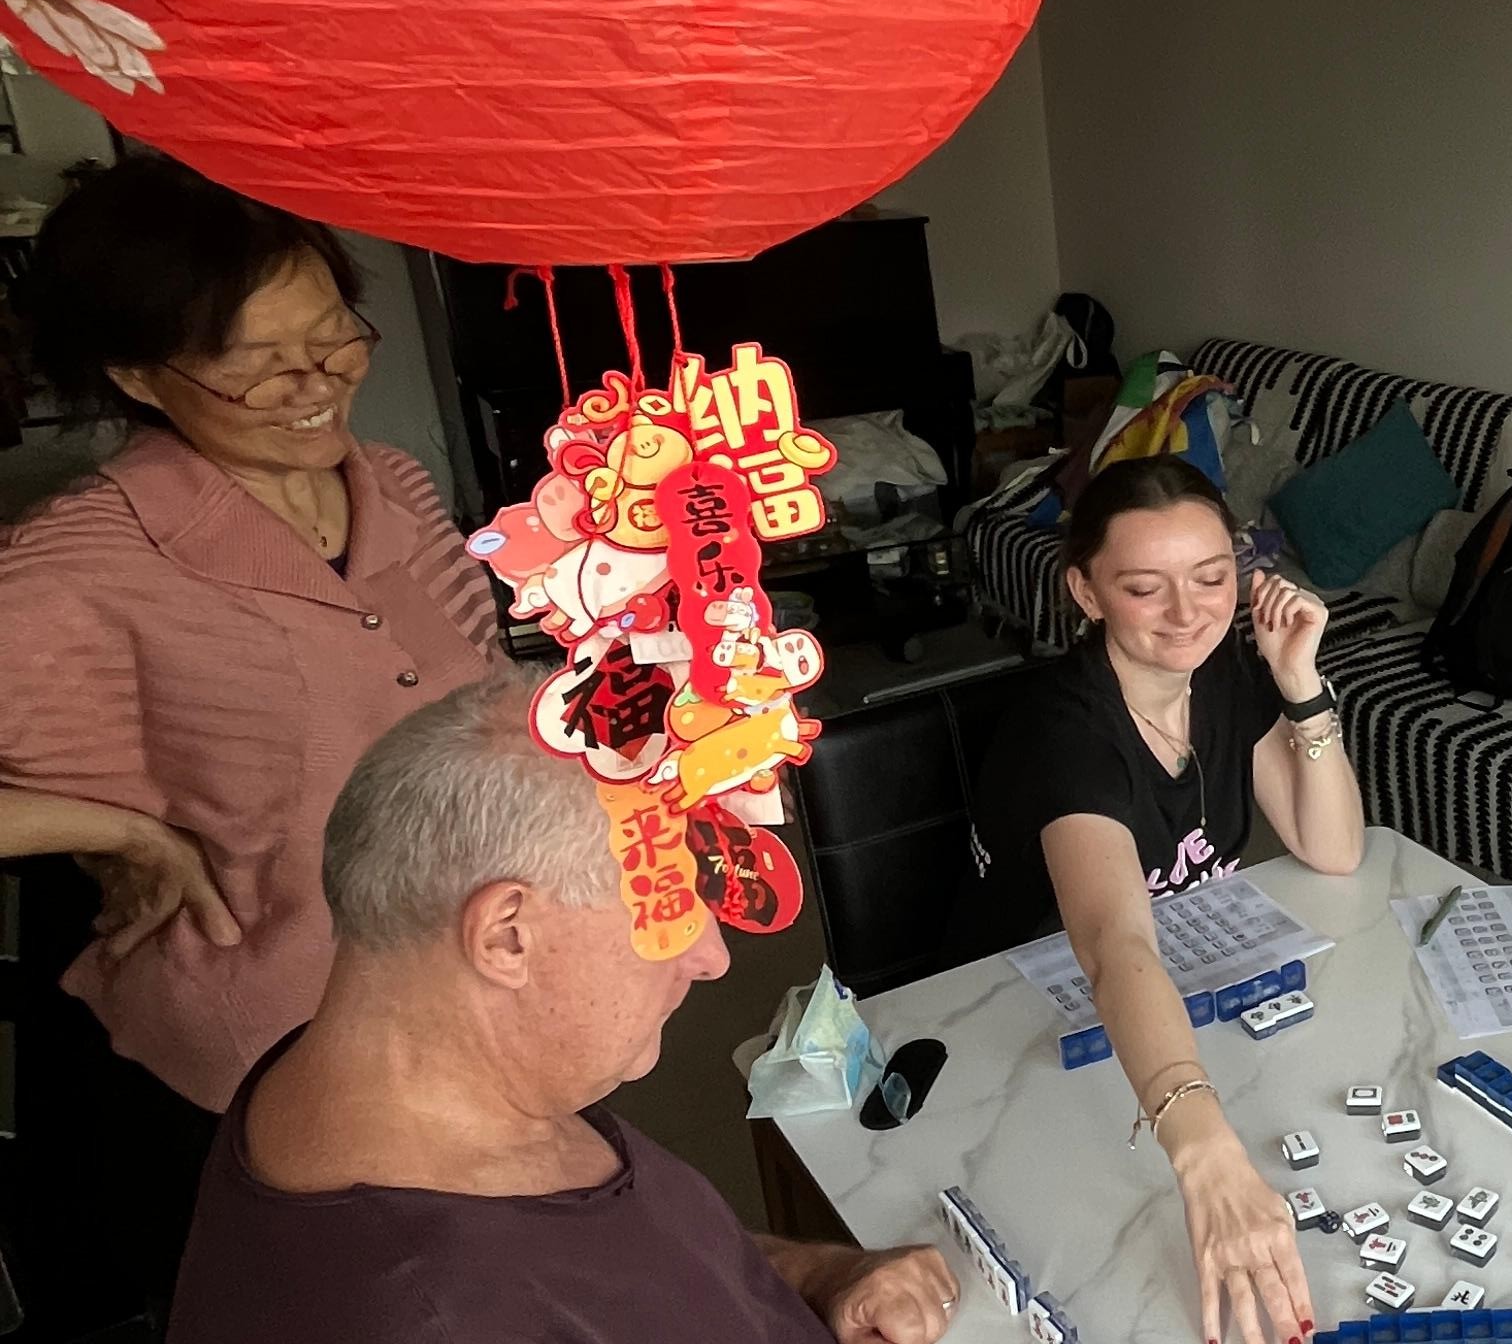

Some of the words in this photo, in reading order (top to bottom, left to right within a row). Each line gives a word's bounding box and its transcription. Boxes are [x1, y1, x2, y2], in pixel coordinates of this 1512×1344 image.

[677, 483, 744, 593] 喜乐
[561, 642, 675, 749] 福
[620, 804, 696, 931] 来福
